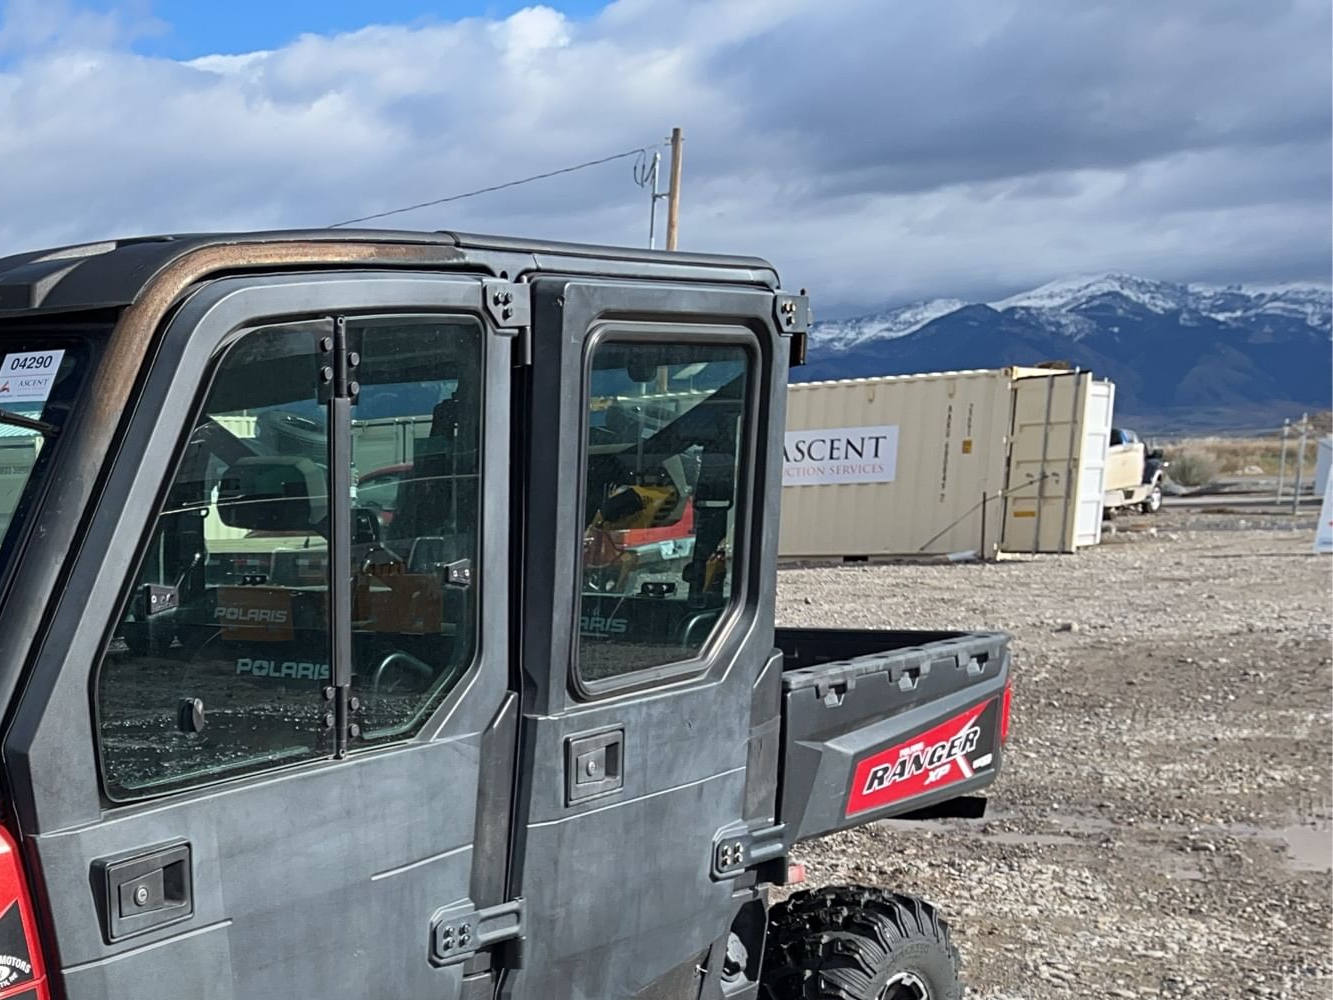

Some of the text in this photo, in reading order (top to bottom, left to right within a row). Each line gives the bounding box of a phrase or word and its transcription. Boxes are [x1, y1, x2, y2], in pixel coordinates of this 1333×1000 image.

[10, 355, 53, 371] 04290
[829, 463, 884, 476] SERVICES
[213, 606, 288, 623] POLARIS
[862, 726, 981, 795] RANGER
[923, 763, 951, 785] XP
